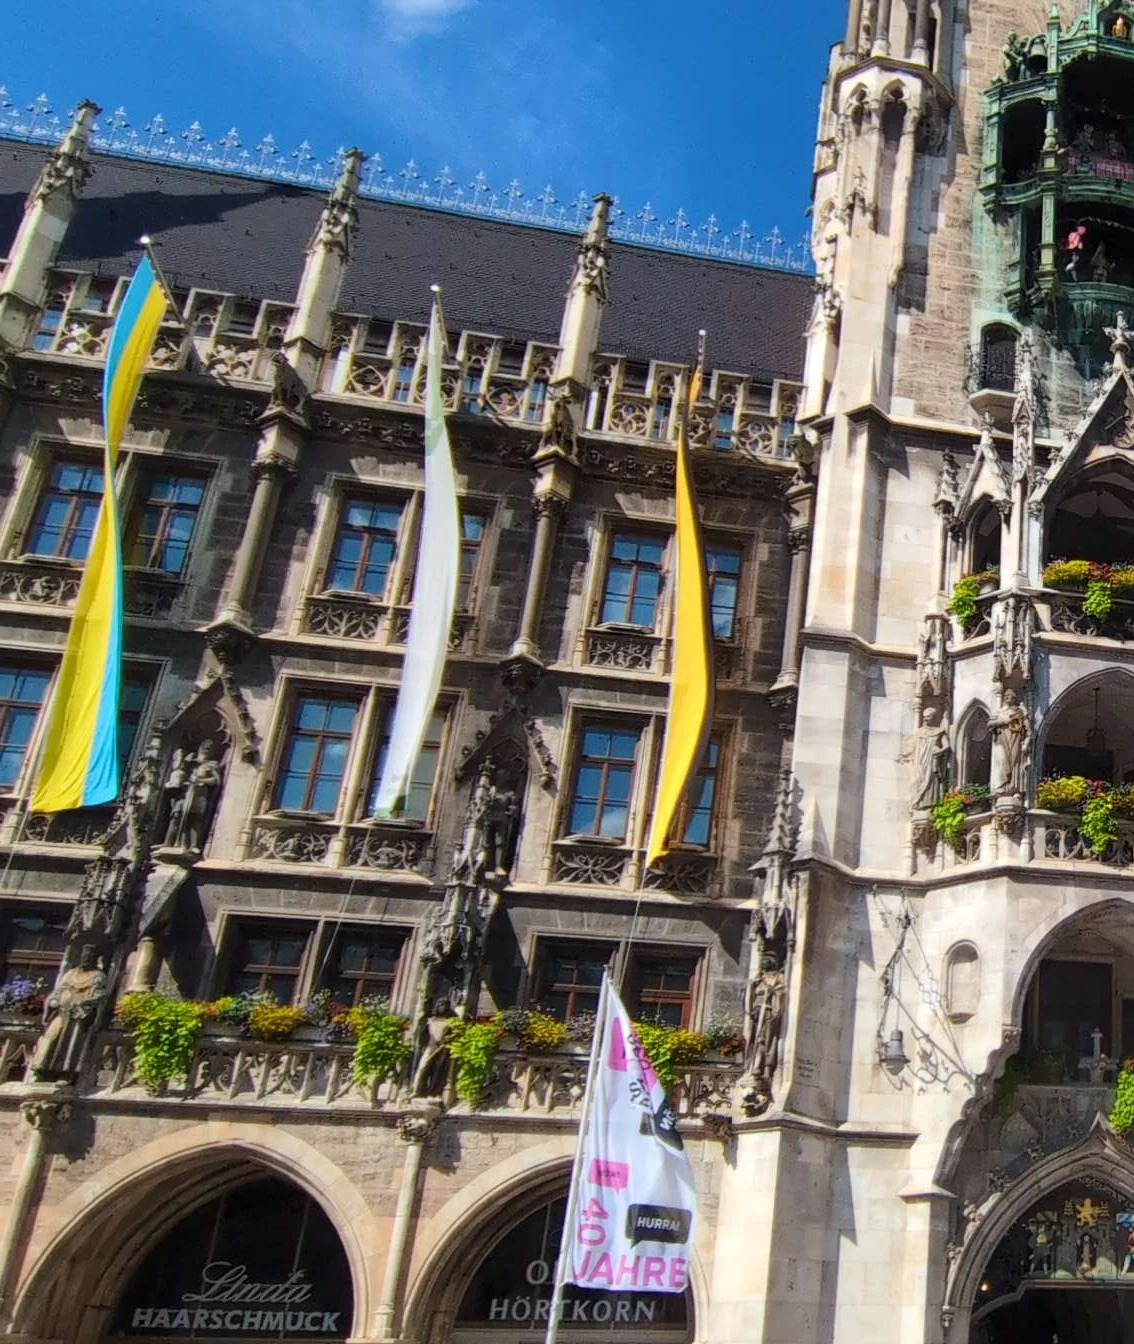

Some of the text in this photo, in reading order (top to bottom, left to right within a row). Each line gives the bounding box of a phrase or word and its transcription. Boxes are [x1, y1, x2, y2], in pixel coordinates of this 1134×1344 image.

[637, 1216, 680, 1231] HURRA!
[574, 1251, 687, 1288] JAHRE
[131, 1307, 341, 1333] HAARSCHMUCK
